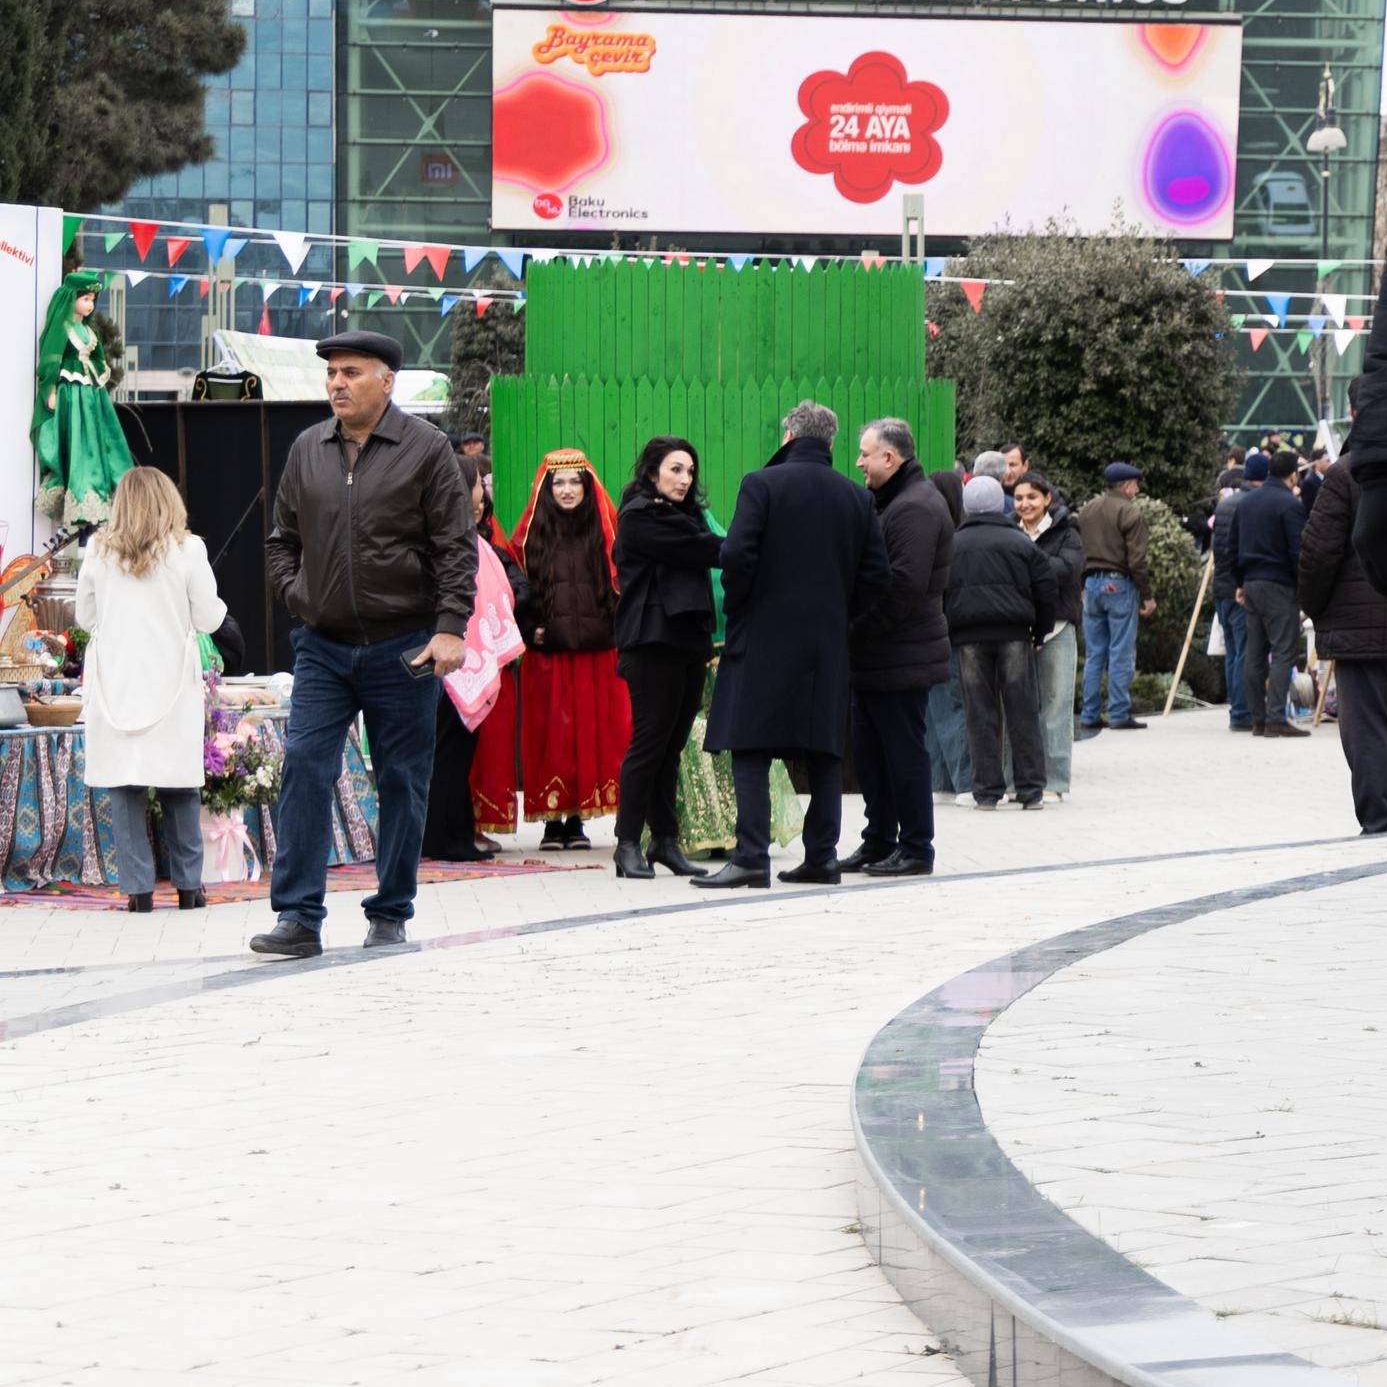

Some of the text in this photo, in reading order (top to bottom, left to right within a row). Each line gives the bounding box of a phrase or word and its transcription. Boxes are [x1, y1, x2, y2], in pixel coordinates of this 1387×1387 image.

[538, 26, 649, 54] Bayrama
[591, 50, 644, 67] çevir
[829, 115, 911, 140] 24 AYA
[568, 195, 605, 207] Baku
[568, 207, 649, 219] Electronics
